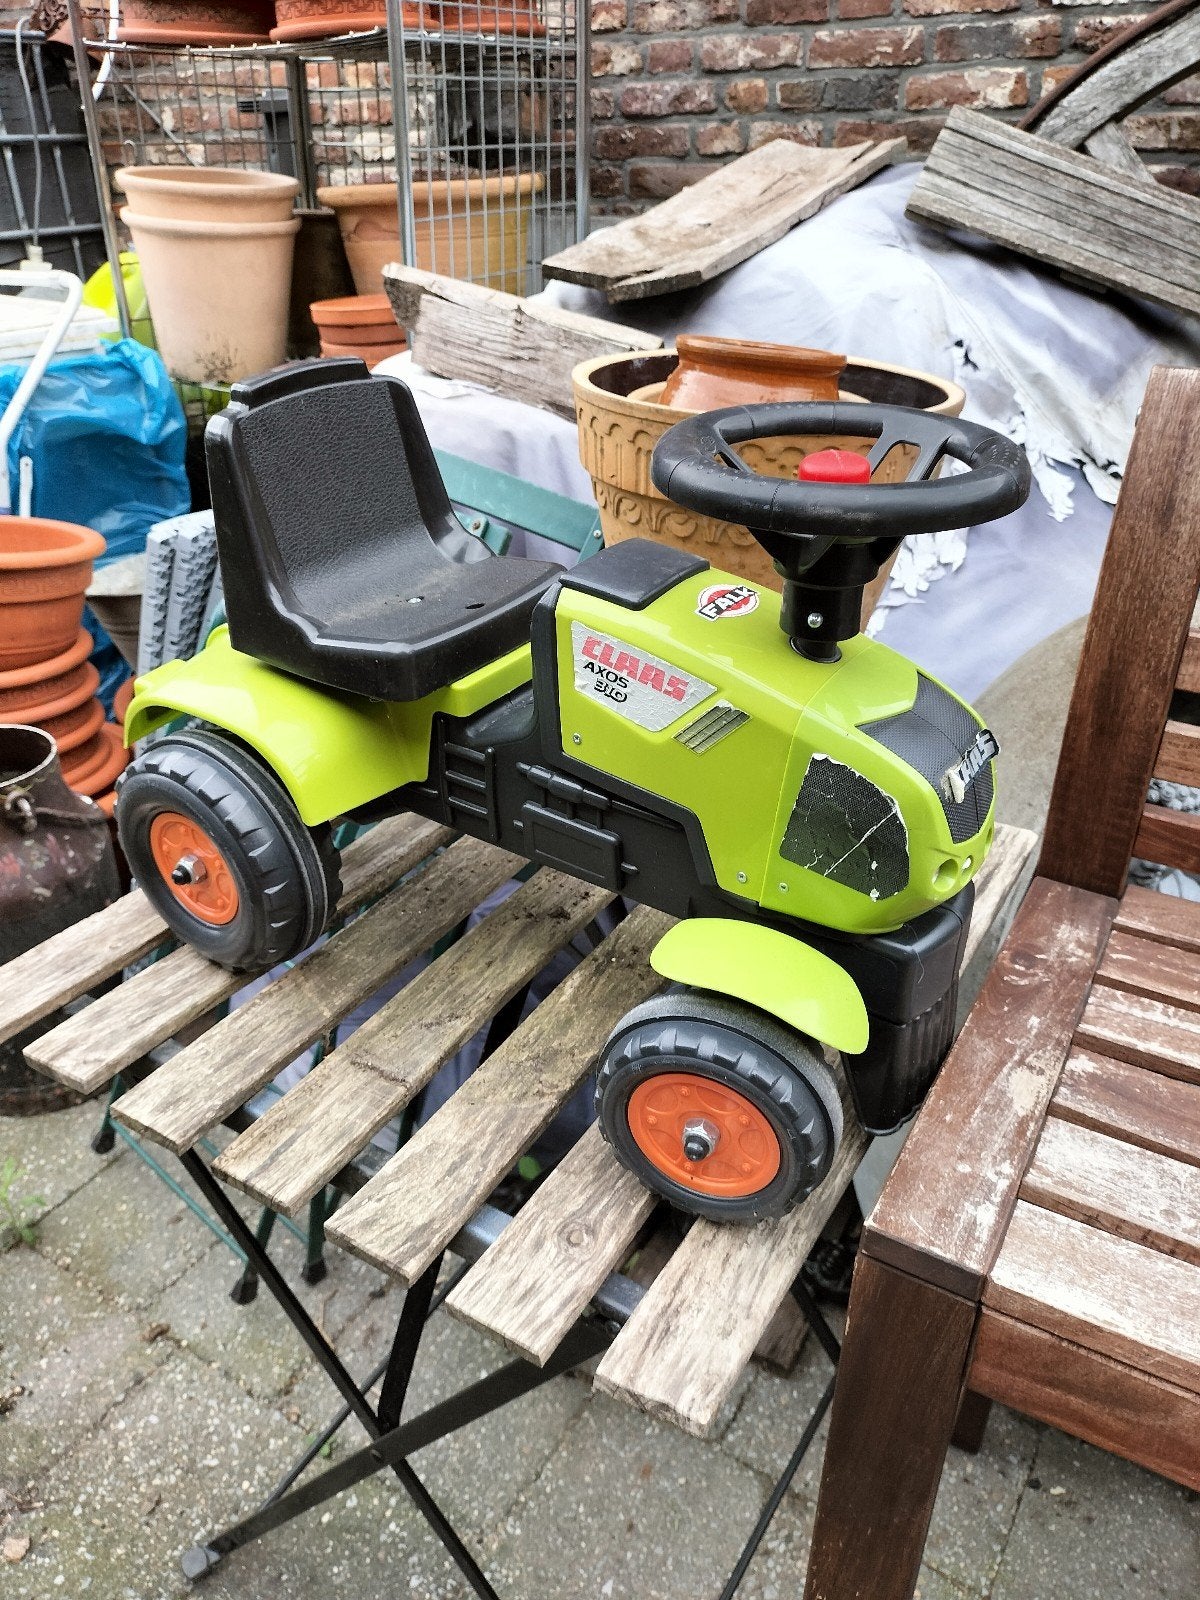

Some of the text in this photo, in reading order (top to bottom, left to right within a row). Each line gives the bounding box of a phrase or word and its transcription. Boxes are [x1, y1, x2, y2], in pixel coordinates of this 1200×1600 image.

[699, 586, 756, 619] FALK
[581, 636, 689, 702] CLAAS
[583, 661, 629, 689] AXOS
[594, 678, 628, 703] 310
